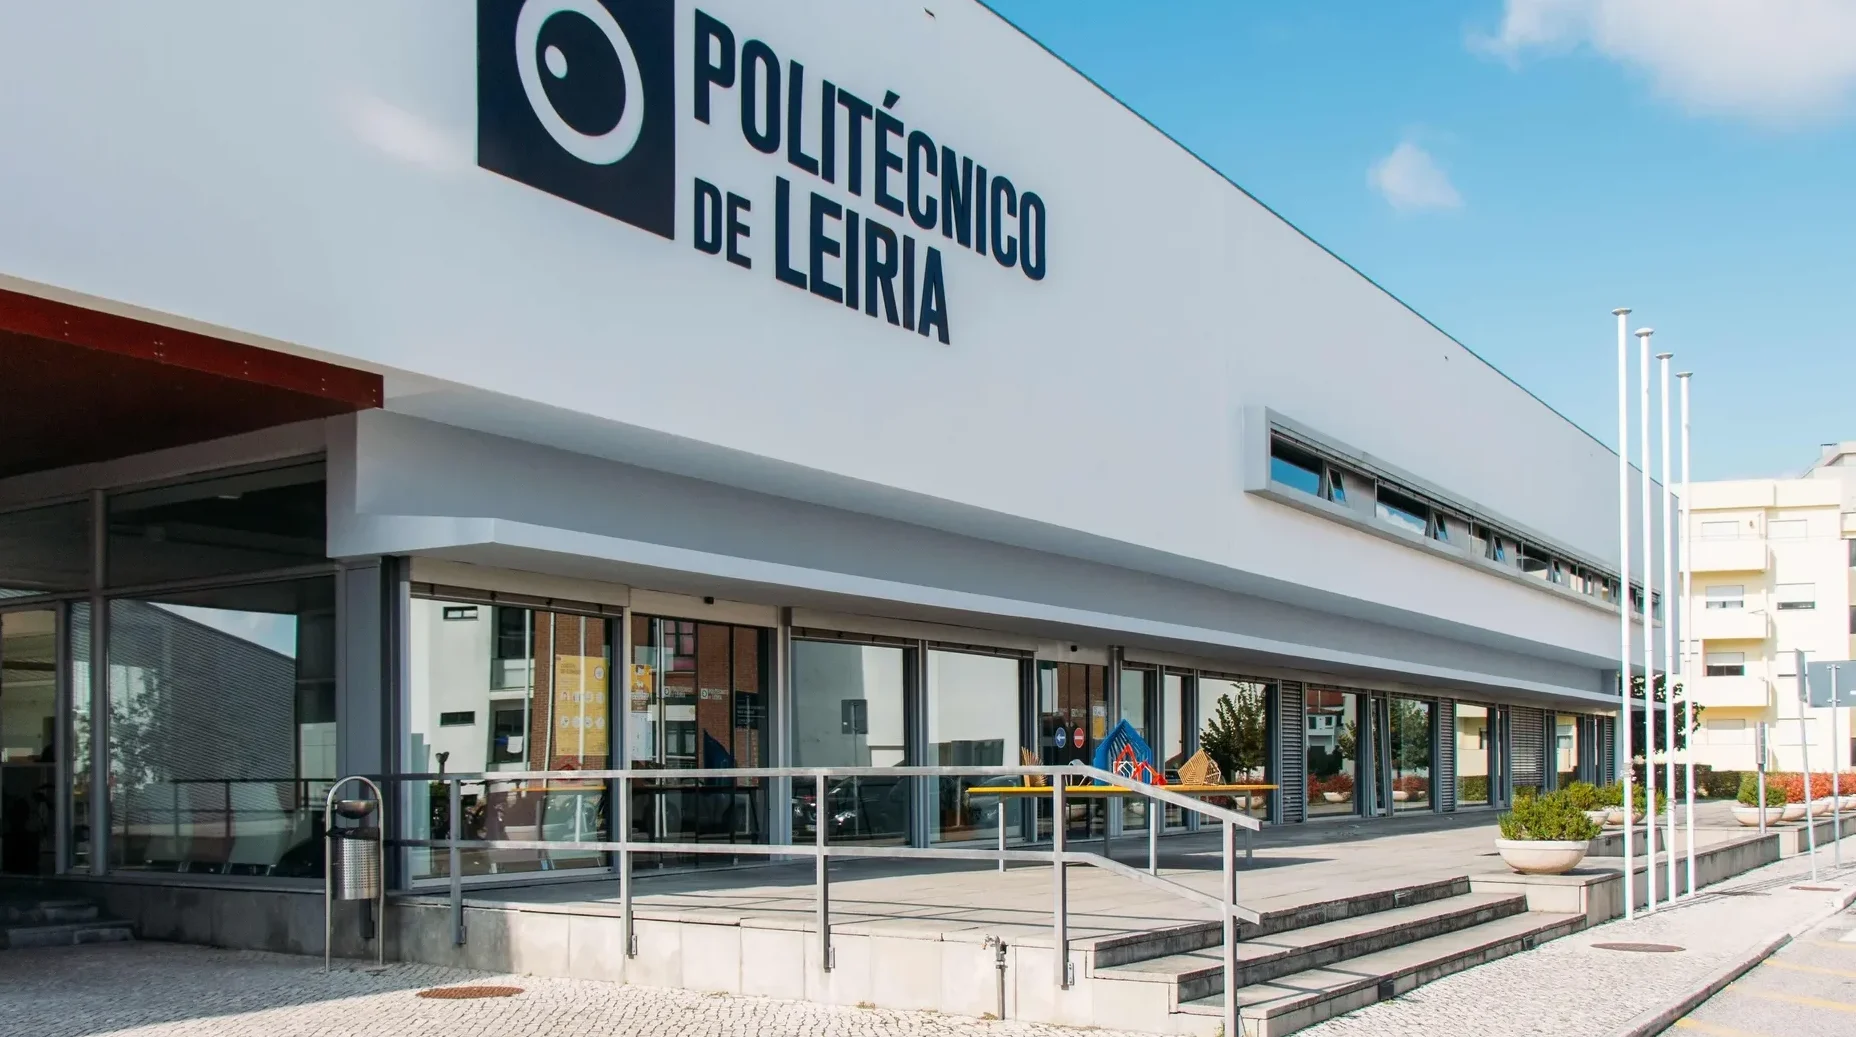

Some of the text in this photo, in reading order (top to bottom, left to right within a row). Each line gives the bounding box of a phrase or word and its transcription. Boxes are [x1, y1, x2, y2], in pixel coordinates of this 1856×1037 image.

[693, 8, 1046, 281] POLITÉCNICO
[693, 175, 951, 346] DE LEIRIA
